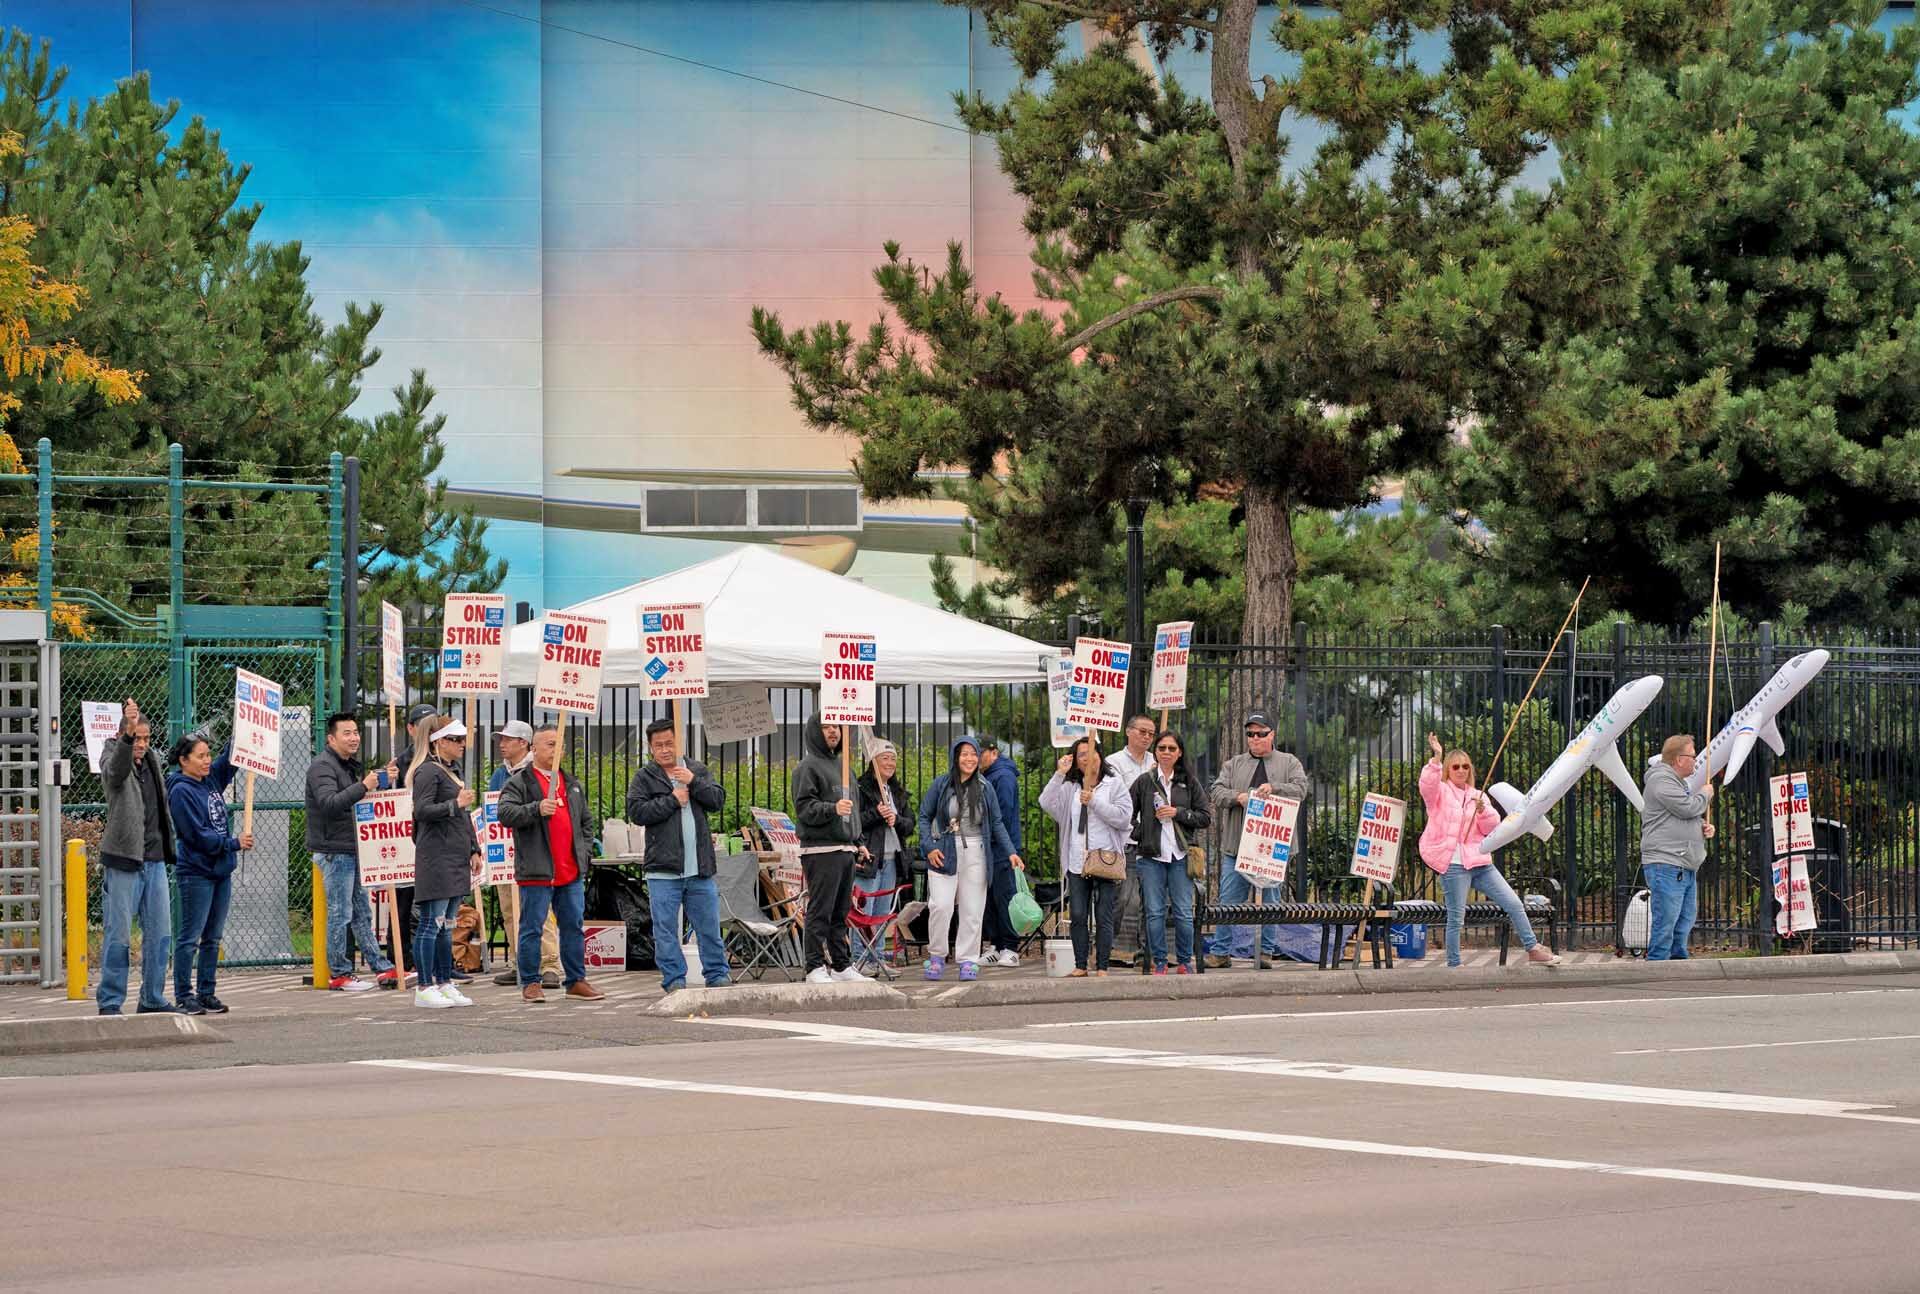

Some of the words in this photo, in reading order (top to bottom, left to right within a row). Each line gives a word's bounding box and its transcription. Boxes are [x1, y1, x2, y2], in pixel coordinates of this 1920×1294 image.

[464, 604, 485, 622] ON
[662, 613, 684, 631] ON
[447, 627, 500, 645] STRIKE
[564, 624, 588, 643] ON
[1167, 633, 1179, 648] ON
[646, 635, 702, 654] STRIKE
[839, 642, 858, 659] ON
[544, 644, 601, 668] STRIKE
[1092, 649, 1112, 666] ON
[1113, 656, 1127, 664] ULP!
[1156, 651, 1187, 667] STRIKE
[824, 663, 873, 680] STRIKE
[1074, 666, 1125, 689] STRIKE
[252, 685, 267, 705] ON
[667, 687, 704, 695] BOEING
[539, 696, 552, 704] AT
[556, 698, 594, 710] BOEING
[239, 702, 278, 732] STRIKE
[840, 714, 873, 722] BOEING
[1070, 715, 1082, 723] AT
[1084, 717, 1119, 728] BOEING
[235, 754, 245, 764] AT
[247, 758, 276, 775] BOEING
[374, 801, 395, 818] ON
[1263, 804, 1282, 821] ON
[1375, 804, 1391, 821] ON
[360, 820, 413, 841] STRIKE
[1246, 819, 1291, 842] STRIKE
[1362, 820, 1398, 843] STRIKE
[1252, 865, 1282, 877] BOEING
[1366, 868, 1390, 879] BOEING
[1776, 879, 1807, 898] STRKE
